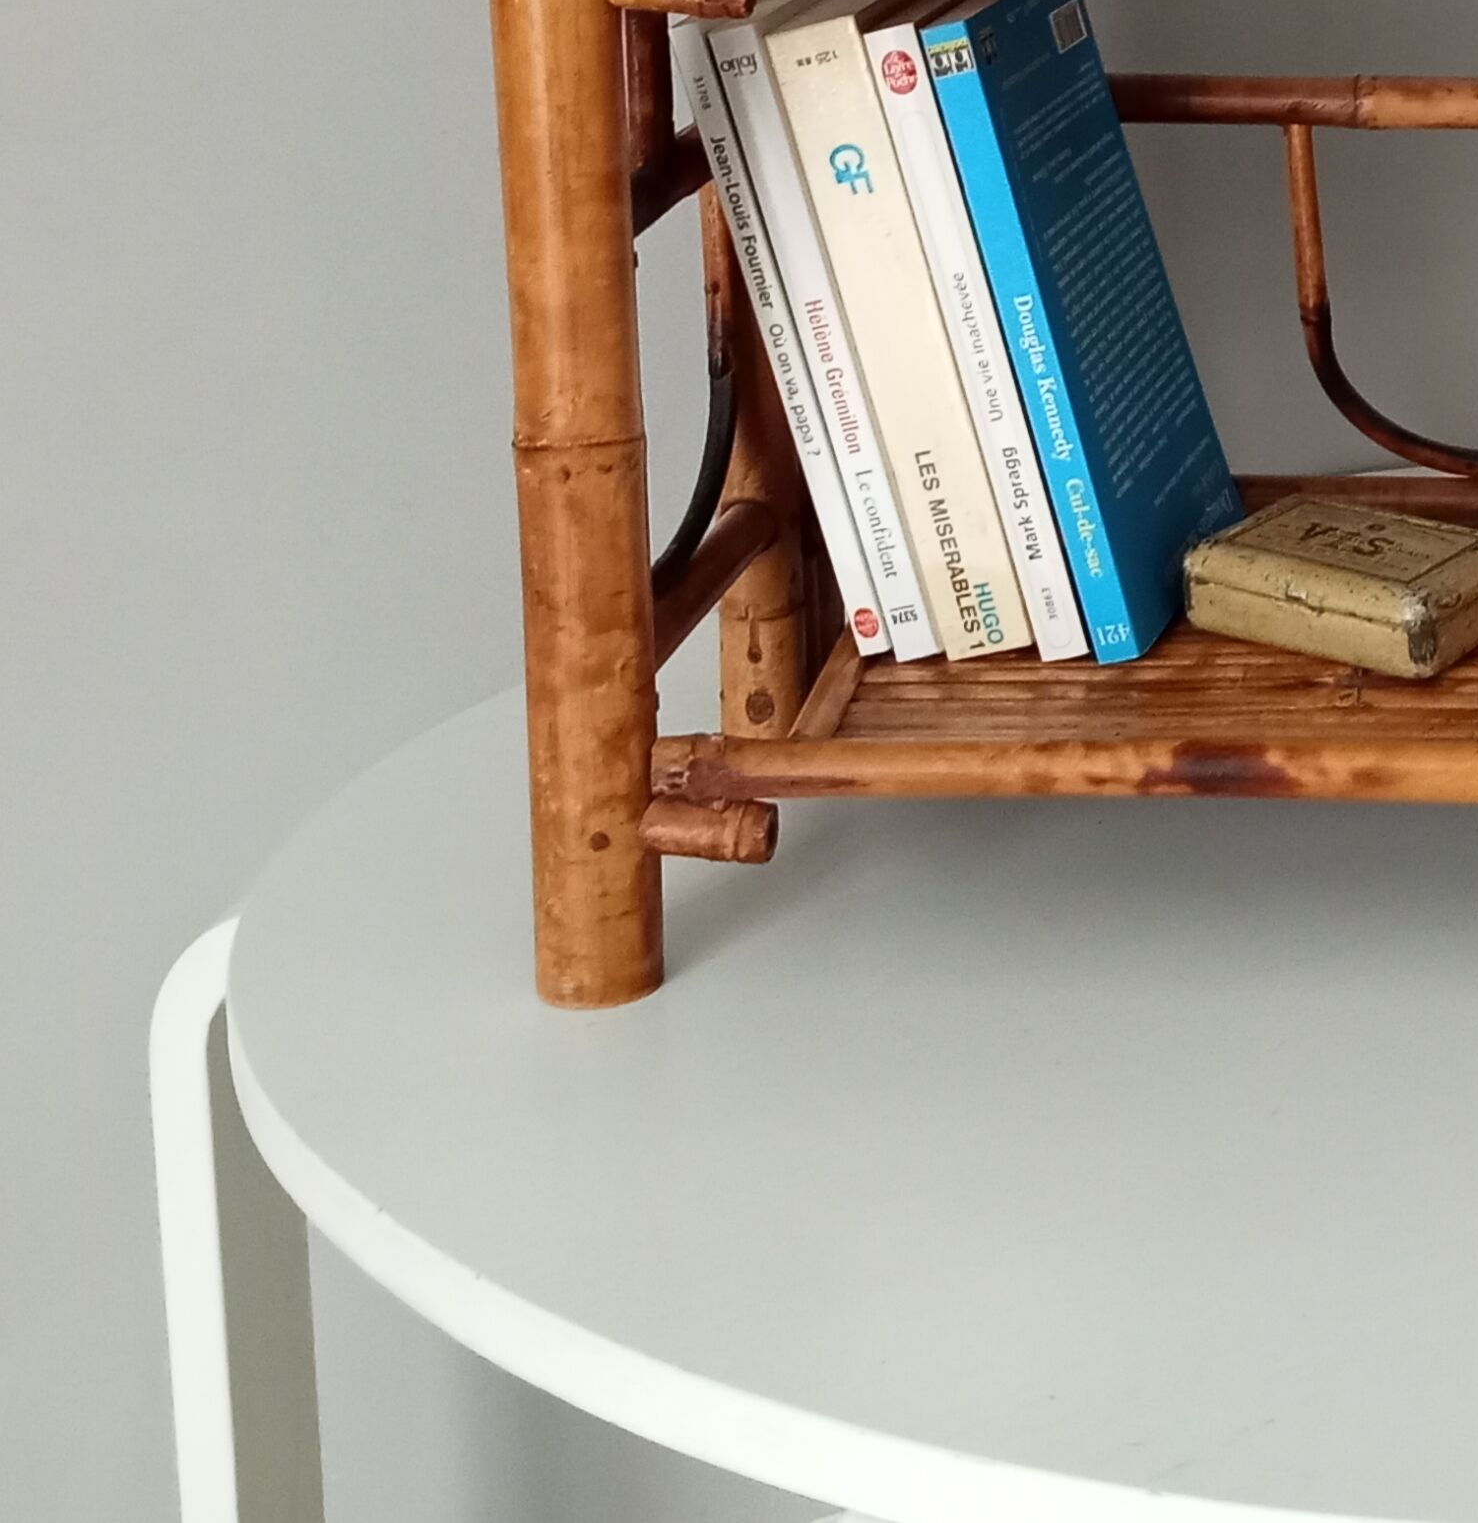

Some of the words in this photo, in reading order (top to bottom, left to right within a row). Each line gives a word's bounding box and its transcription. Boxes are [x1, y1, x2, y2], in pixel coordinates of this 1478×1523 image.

[720, 52, 759, 77] folio
[814, 49, 839, 66] 125
[710, 135, 752, 232] Jean-Louis
[829, 143, 874, 195] GF
[741, 235, 775, 310] Fournier
[804, 298, 834, 364] Hélène
[953, 271, 985, 354] inachevée
[768, 323, 786, 350] Où
[777, 353, 793, 374] on
[976, 359, 994, 384] vie
[785, 378, 799, 401] va,
[825, 366, 862, 455] Grémillon
[988, 388, 1004, 423] Une
[790, 403, 815, 444] papa
[1013, 293, 1046, 376] Douglas
[1037, 378, 1074, 462] Kennedy
[1064, 477, 1104, 579] Cul-de-sac
[806, 448, 821, 457] ?
[854, 468, 874, 492] Le
[1002, 446, 1031, 510] Spragg
[862, 495, 899, 579] confident
[914, 449, 941, 492] LES
[928, 498, 982, 634] MISERABLES
[969, 639, 986, 651] 1
[1018, 516, 1043, 561] Mark
[890, 609, 919, 625] 5374
[973, 581, 1005, 645] HUGO
[1098, 622, 1132, 646] 421
